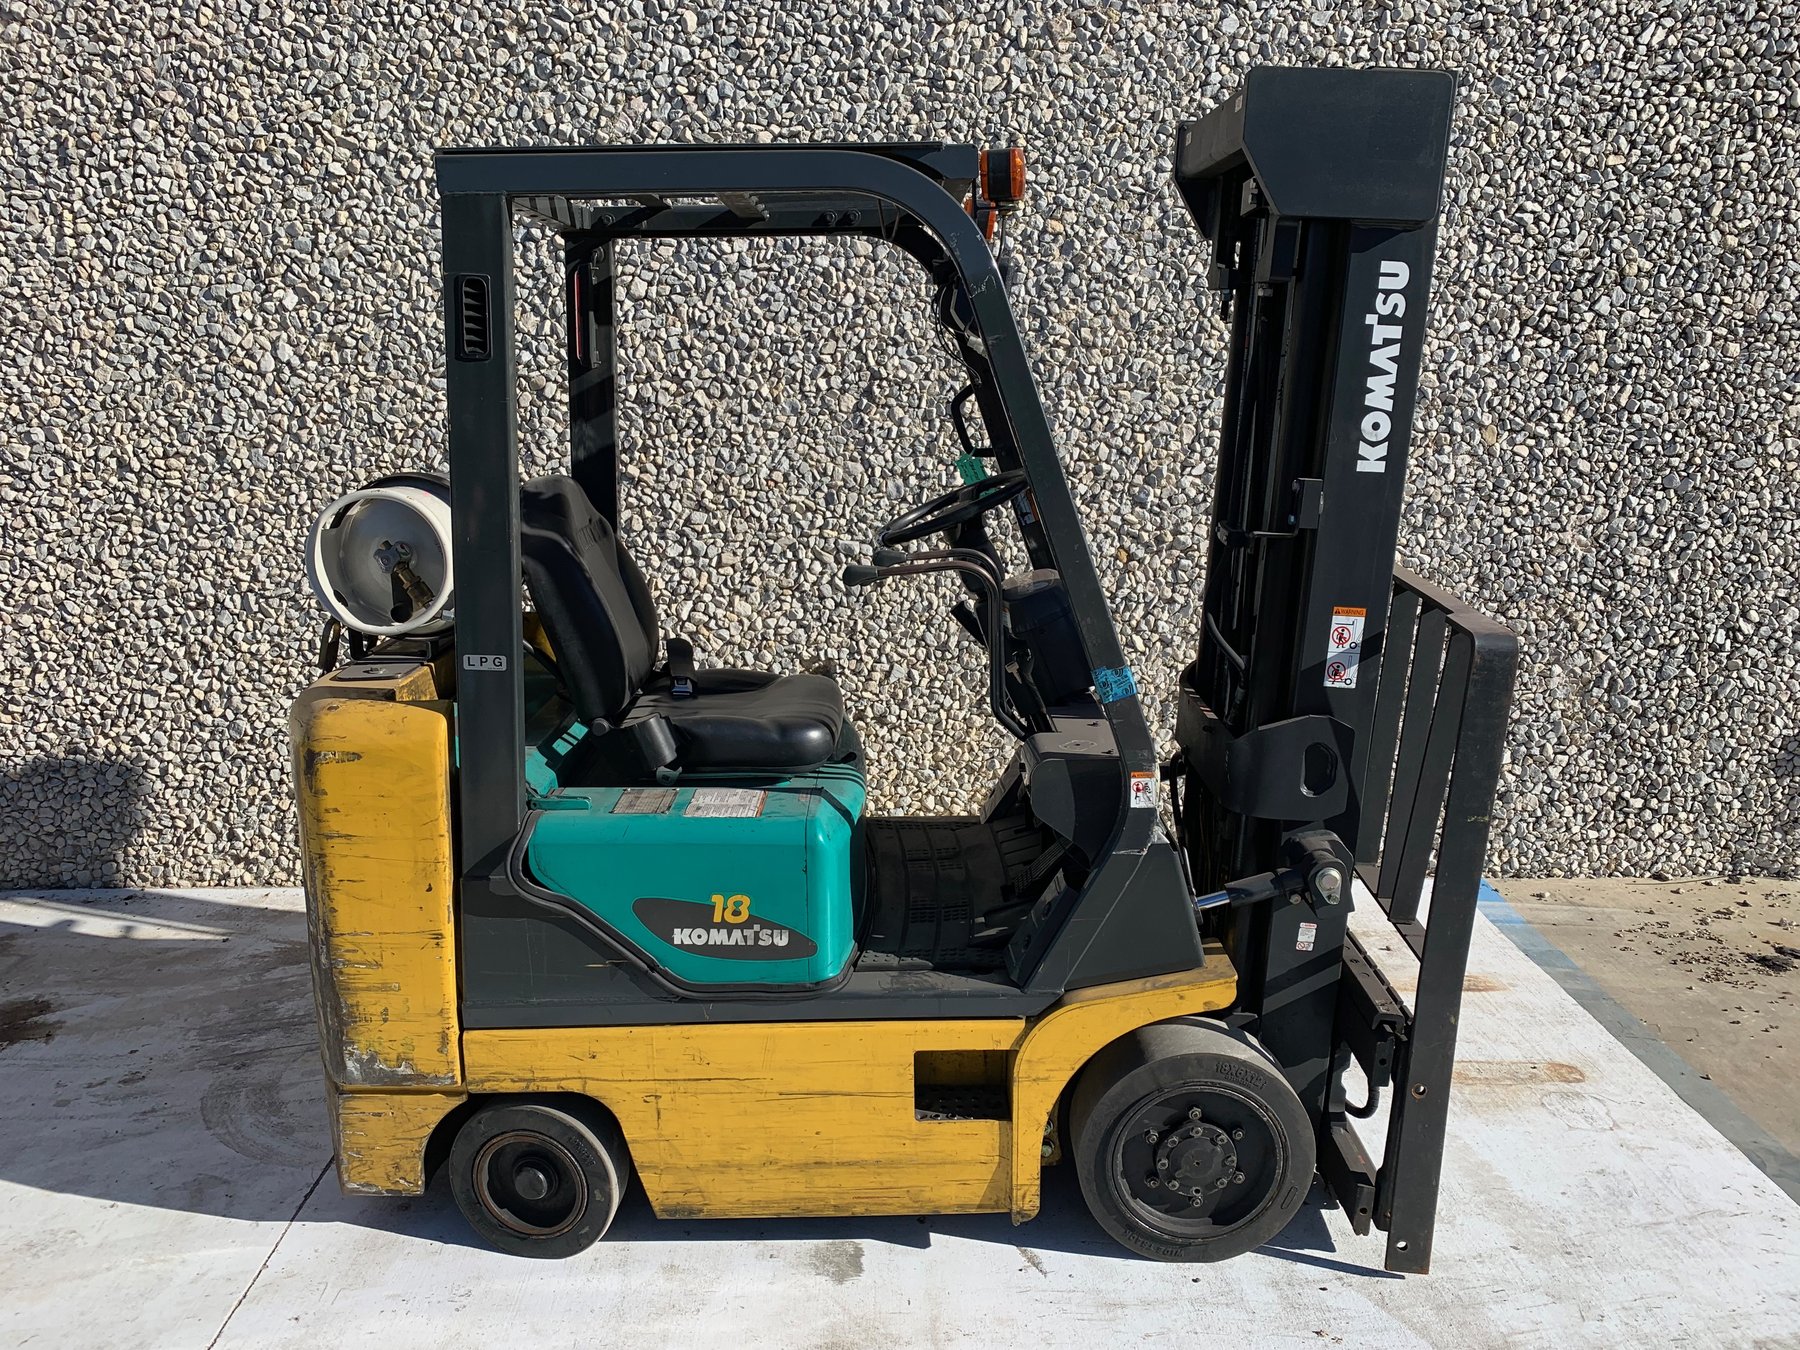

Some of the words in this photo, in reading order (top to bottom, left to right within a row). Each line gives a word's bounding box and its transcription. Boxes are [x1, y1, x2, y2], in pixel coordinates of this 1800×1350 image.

[1356, 260, 1410, 473] KOMATSU
[711, 894, 751, 924] 18
[673, 924, 789, 947] KOMATSU
